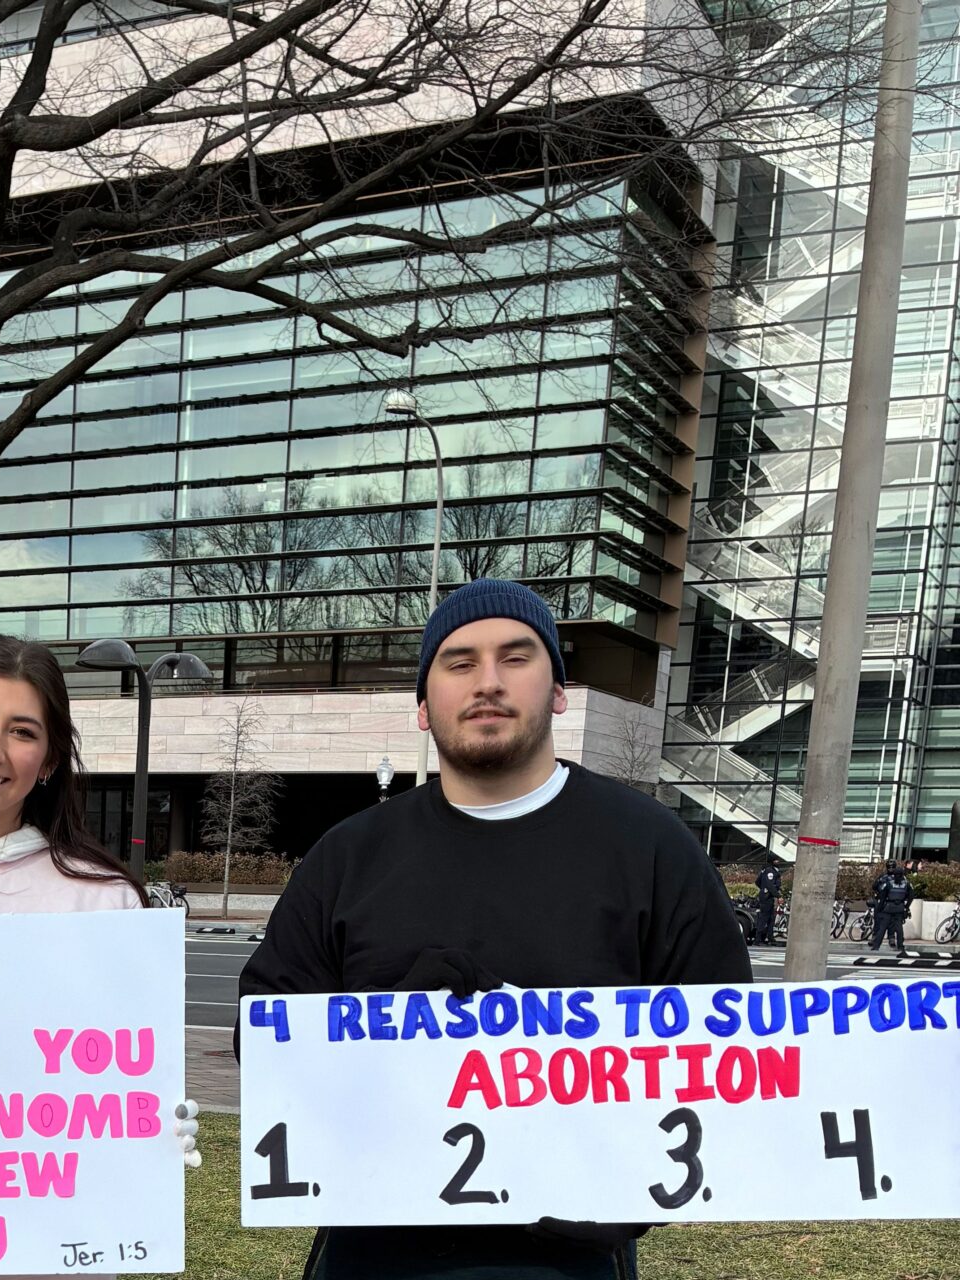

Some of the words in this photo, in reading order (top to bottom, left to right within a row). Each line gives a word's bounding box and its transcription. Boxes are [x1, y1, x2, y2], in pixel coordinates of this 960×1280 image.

[250, 999, 290, 1043] 4
[327, 989, 600, 1042] REASONS
[616, 987, 690, 1038] TO
[704, 980, 960, 1036] SUPPORT
[33, 1027, 155, 1077] YOU
[446, 1043, 801, 1110] ABORTION
[250, 1121, 321, 1200] 1.
[438, 1122, 509, 1205] 2.
[648, 1107, 713, 1210] 3.
[820, 1108, 893, 1201] 4.
[61, 1242, 104, 1268] Jer.
[119, 1241, 148, 1262] 1:5
